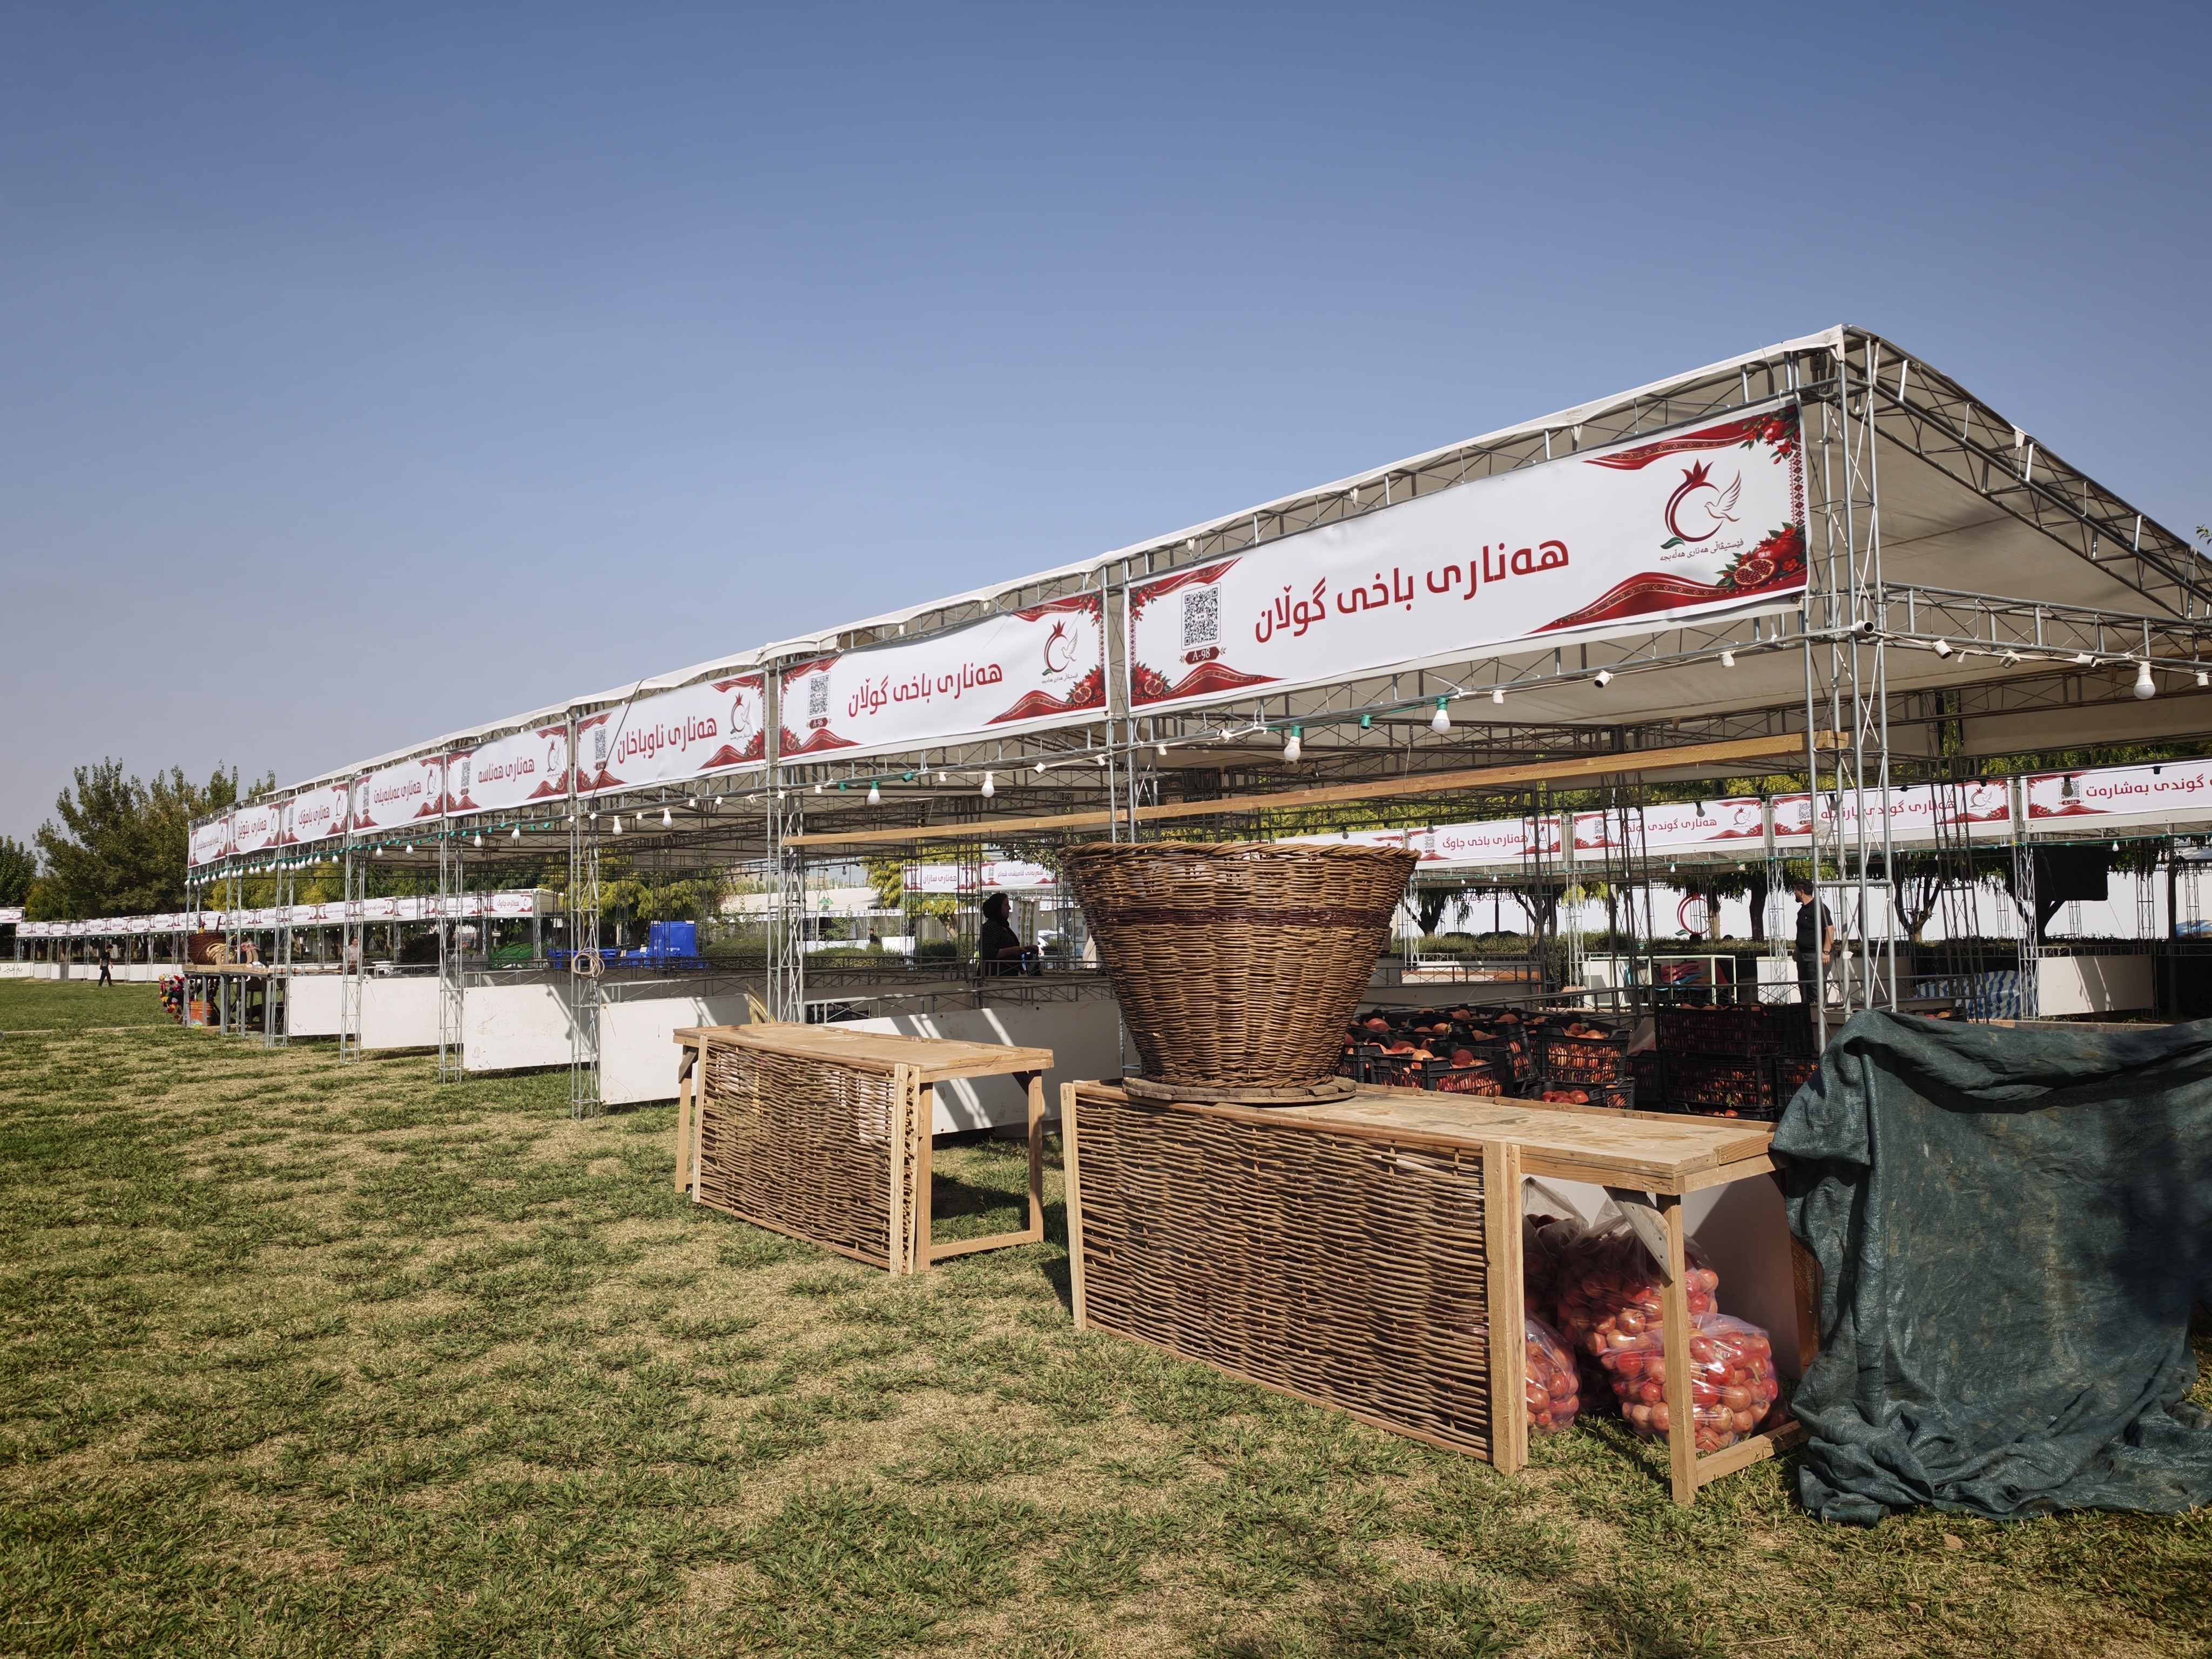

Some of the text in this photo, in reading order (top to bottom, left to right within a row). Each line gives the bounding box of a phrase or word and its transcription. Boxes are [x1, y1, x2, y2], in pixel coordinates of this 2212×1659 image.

[1660, 538, 1744, 562] فێستیڤاڵی هەناری هەڵەبجە
[1255, 539, 1569, 643] هەناری باخی گوڵان
[1192, 648, 1210, 662] A-98
[848, 662, 1003, 718] هەناری باخی گوڵان
[617, 716, 717, 764] هەناری ناوباخان
[478, 756, 535, 784] هەناری هەناسە
[401, 780, 421, 801] هەناری
[2086, 781, 2149, 799] بەشارەت
[2154, 773, 2204, 792] گوندی
[313, 805, 329, 826] هەناری
[1648, 818, 1678, 832] گوندی
[1681, 818, 1717, 831] هەناری
[251, 818, 267, 837] هەناری
[1442, 834, 1528, 851] هەناری باخی چاوگ
[938, 874, 957, 884] هەناری
